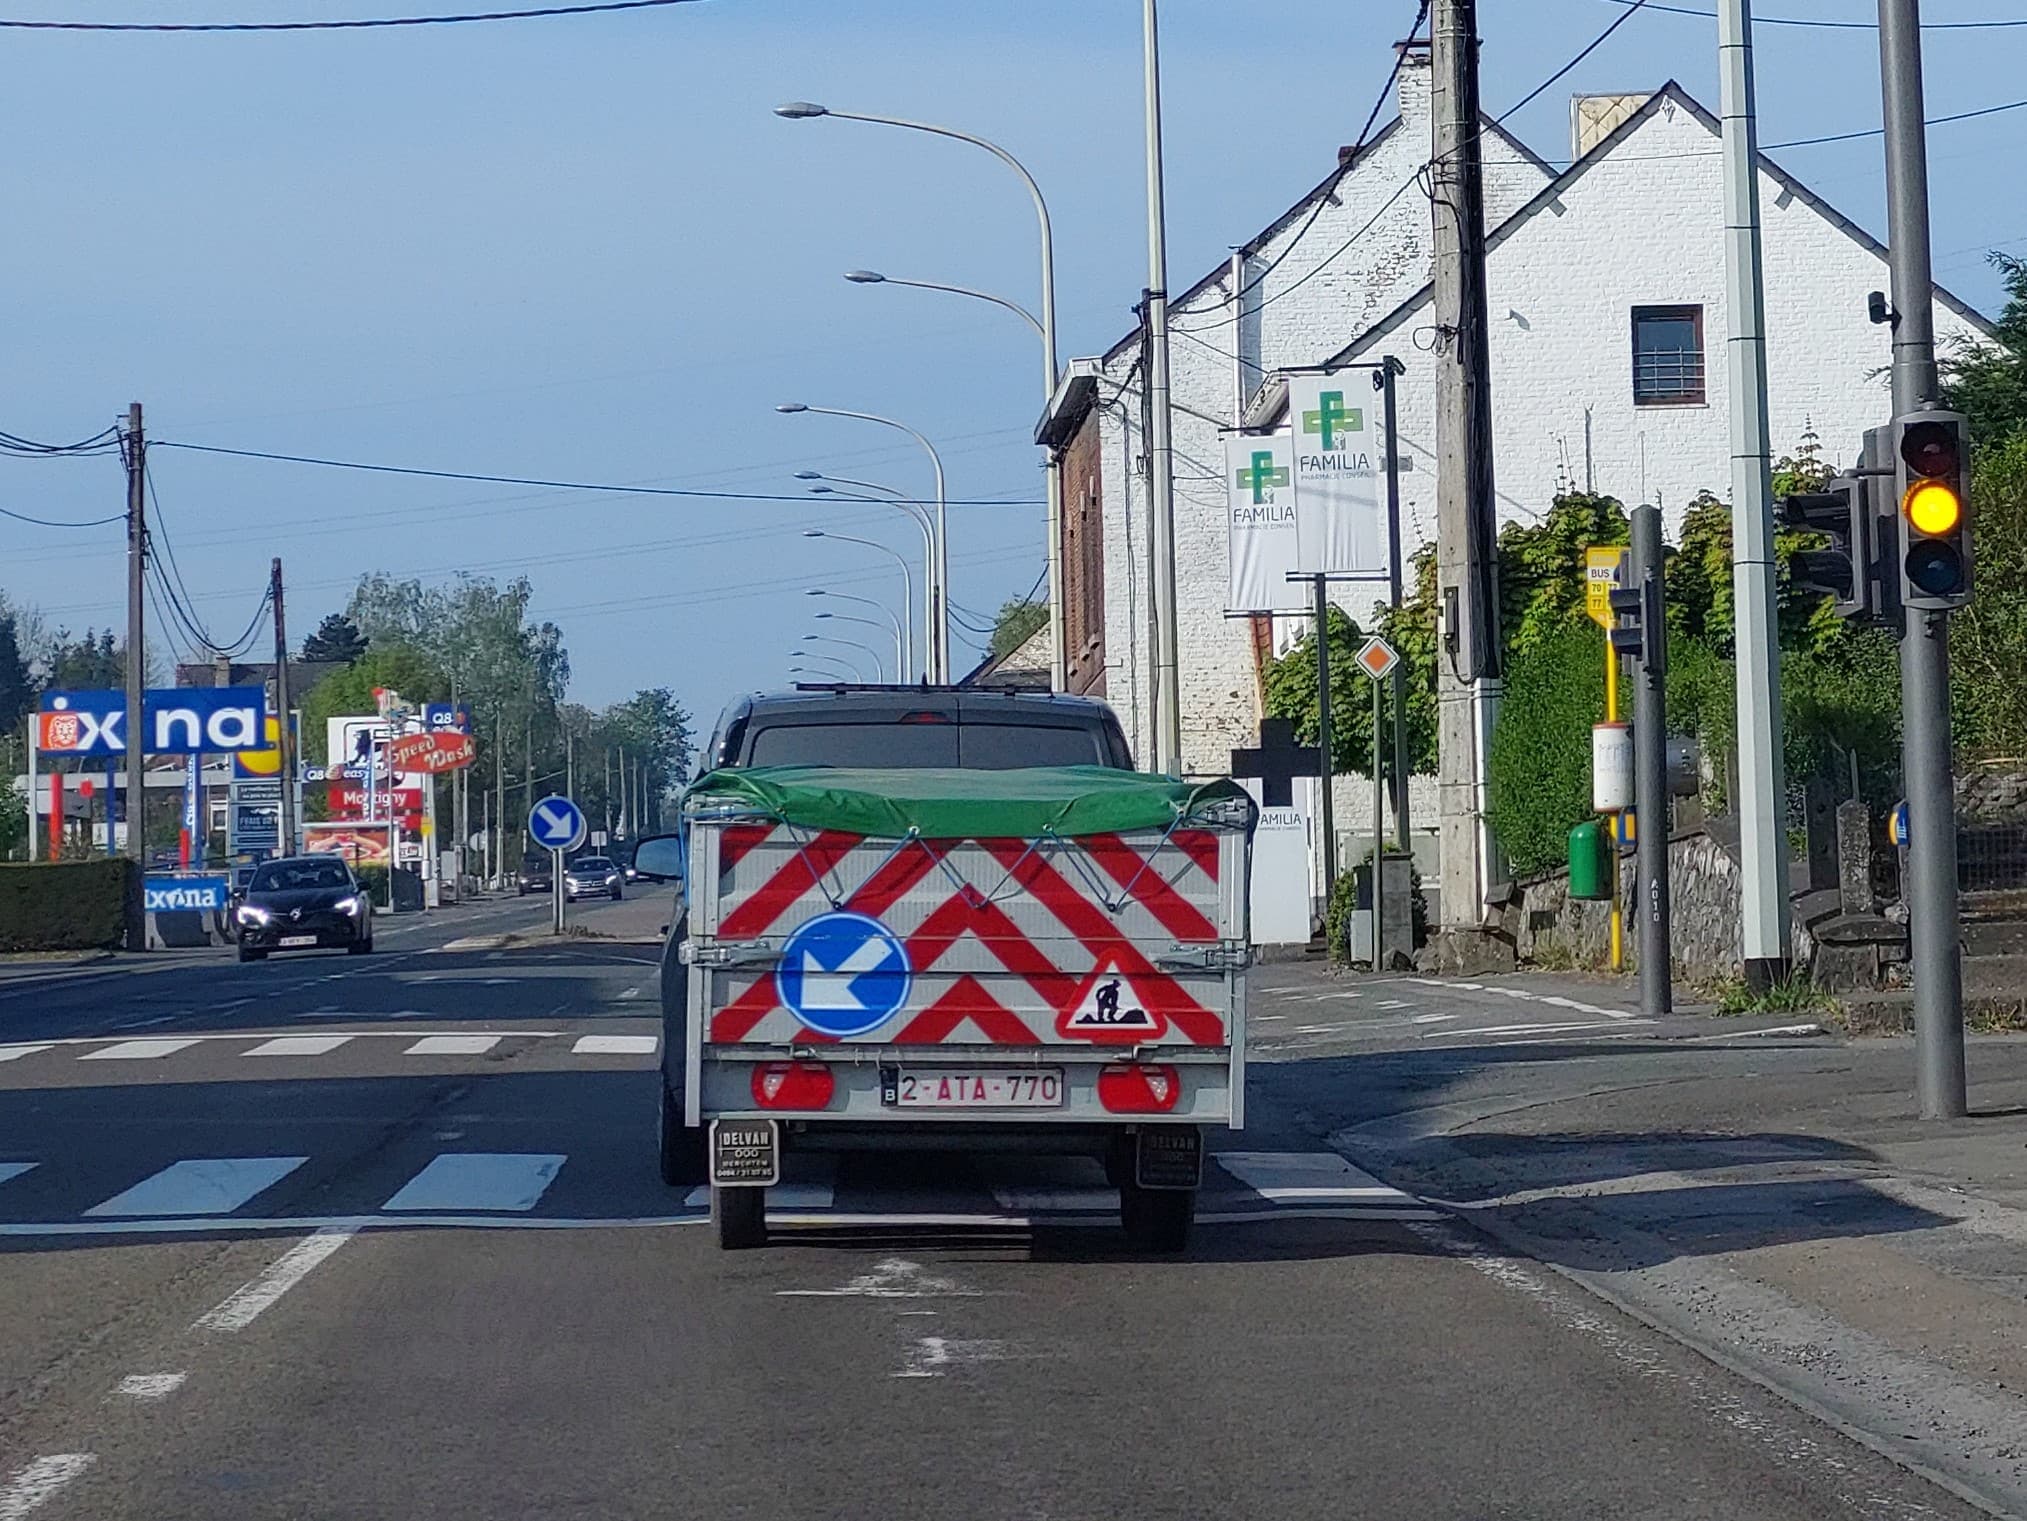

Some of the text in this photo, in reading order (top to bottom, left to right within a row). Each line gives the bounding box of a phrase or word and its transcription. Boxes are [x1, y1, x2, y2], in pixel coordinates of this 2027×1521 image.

[1299, 453, 1370, 472] FAMILIA
[1233, 506, 1295, 523] FAMILIA
[1591, 569, 1610, 578] BUS
[1591, 583, 1602, 593] 70
[1592, 599, 1602, 609] 77
[432, 712, 452, 725] Q8
[423, 738, 475, 771] Wash
[307, 769, 324, 781] Q8
[1260, 813, 1302, 825] AMILIA
[902, 1076, 1058, 1101] 2-ATA-770
[883, 1089, 896, 1102] B
